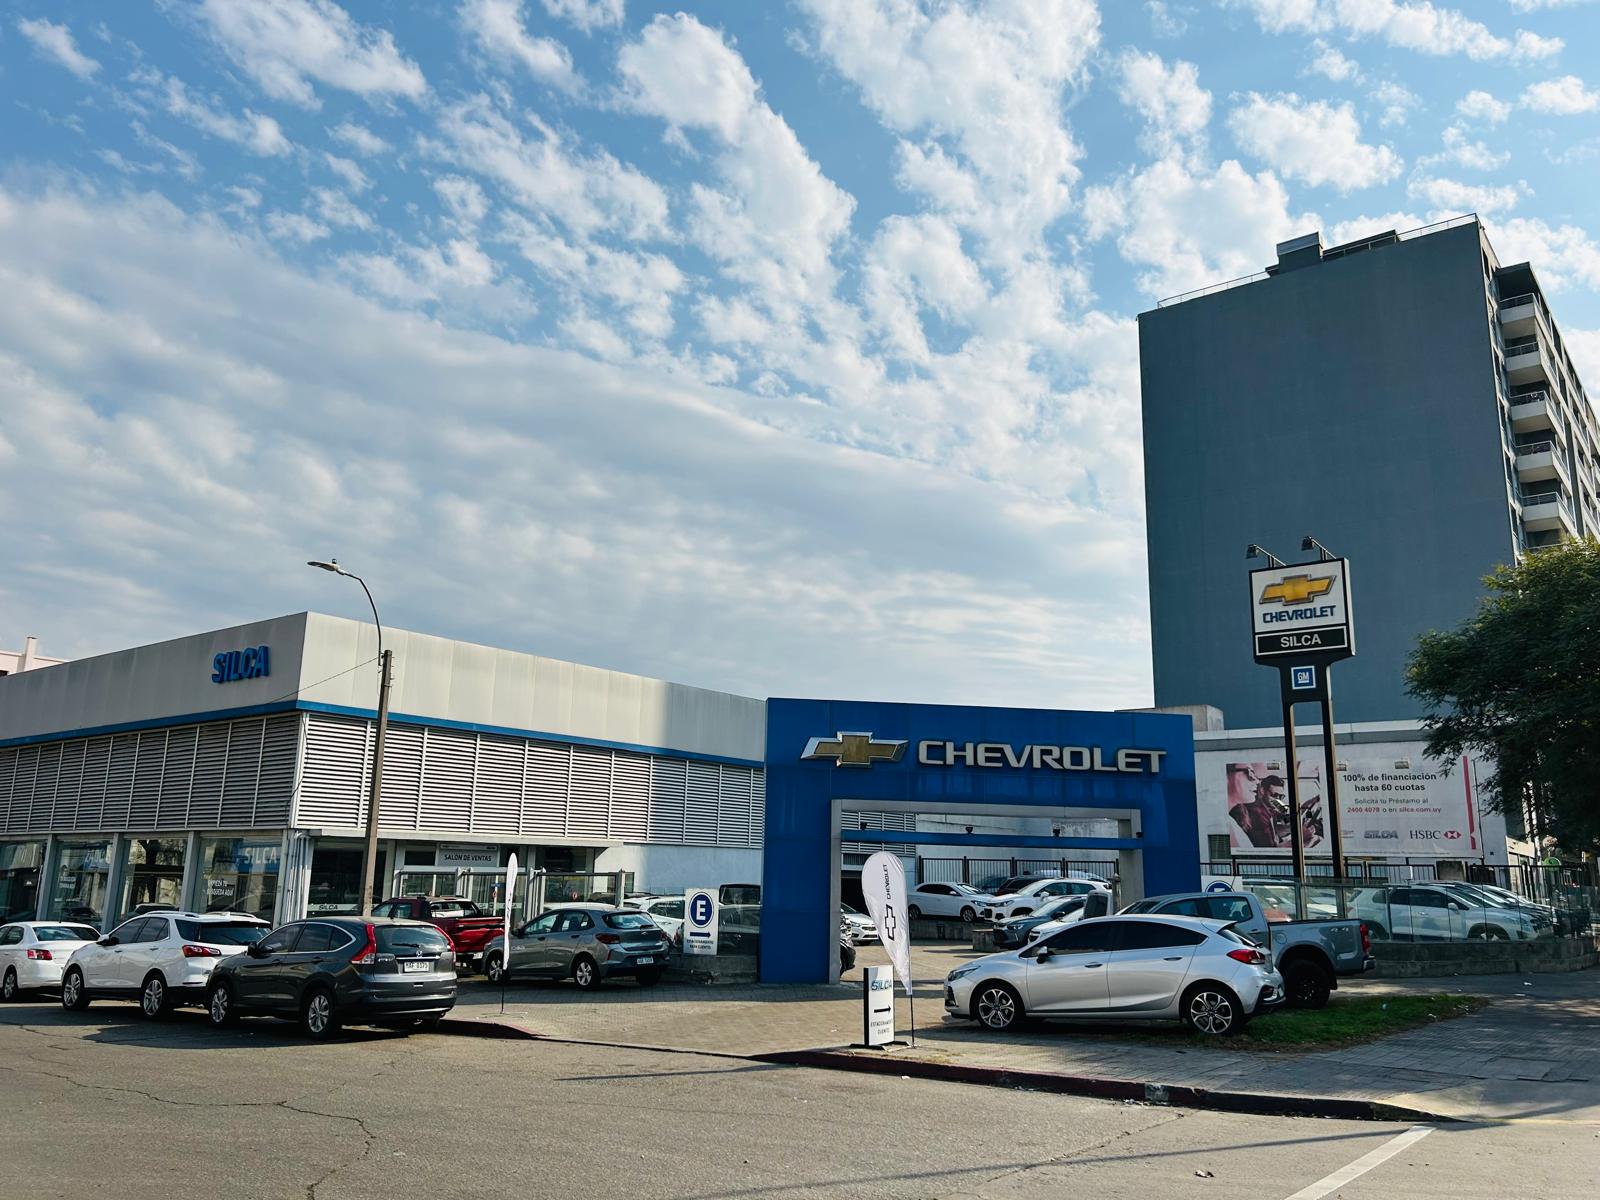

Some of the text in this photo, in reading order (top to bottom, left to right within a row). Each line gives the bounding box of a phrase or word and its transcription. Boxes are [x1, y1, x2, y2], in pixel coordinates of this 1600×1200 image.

[1262, 605, 1336, 624] CHEVROLET
[1280, 633, 1322, 648] SILCA
[211, 645, 270, 684] SILCA
[1297, 671, 1310, 681] GM
[918, 740, 1168, 773] CHEVROLET
[1343, 772, 1437, 782] 100% de financiación
[1354, 783, 1425, 792] hasta 60 cuotas
[1409, 830, 1441, 840] HSBC
[244, 847, 278, 864] SILCA
[883, 864, 891, 900] CHEVROLET
[696, 899, 707, 921] E
